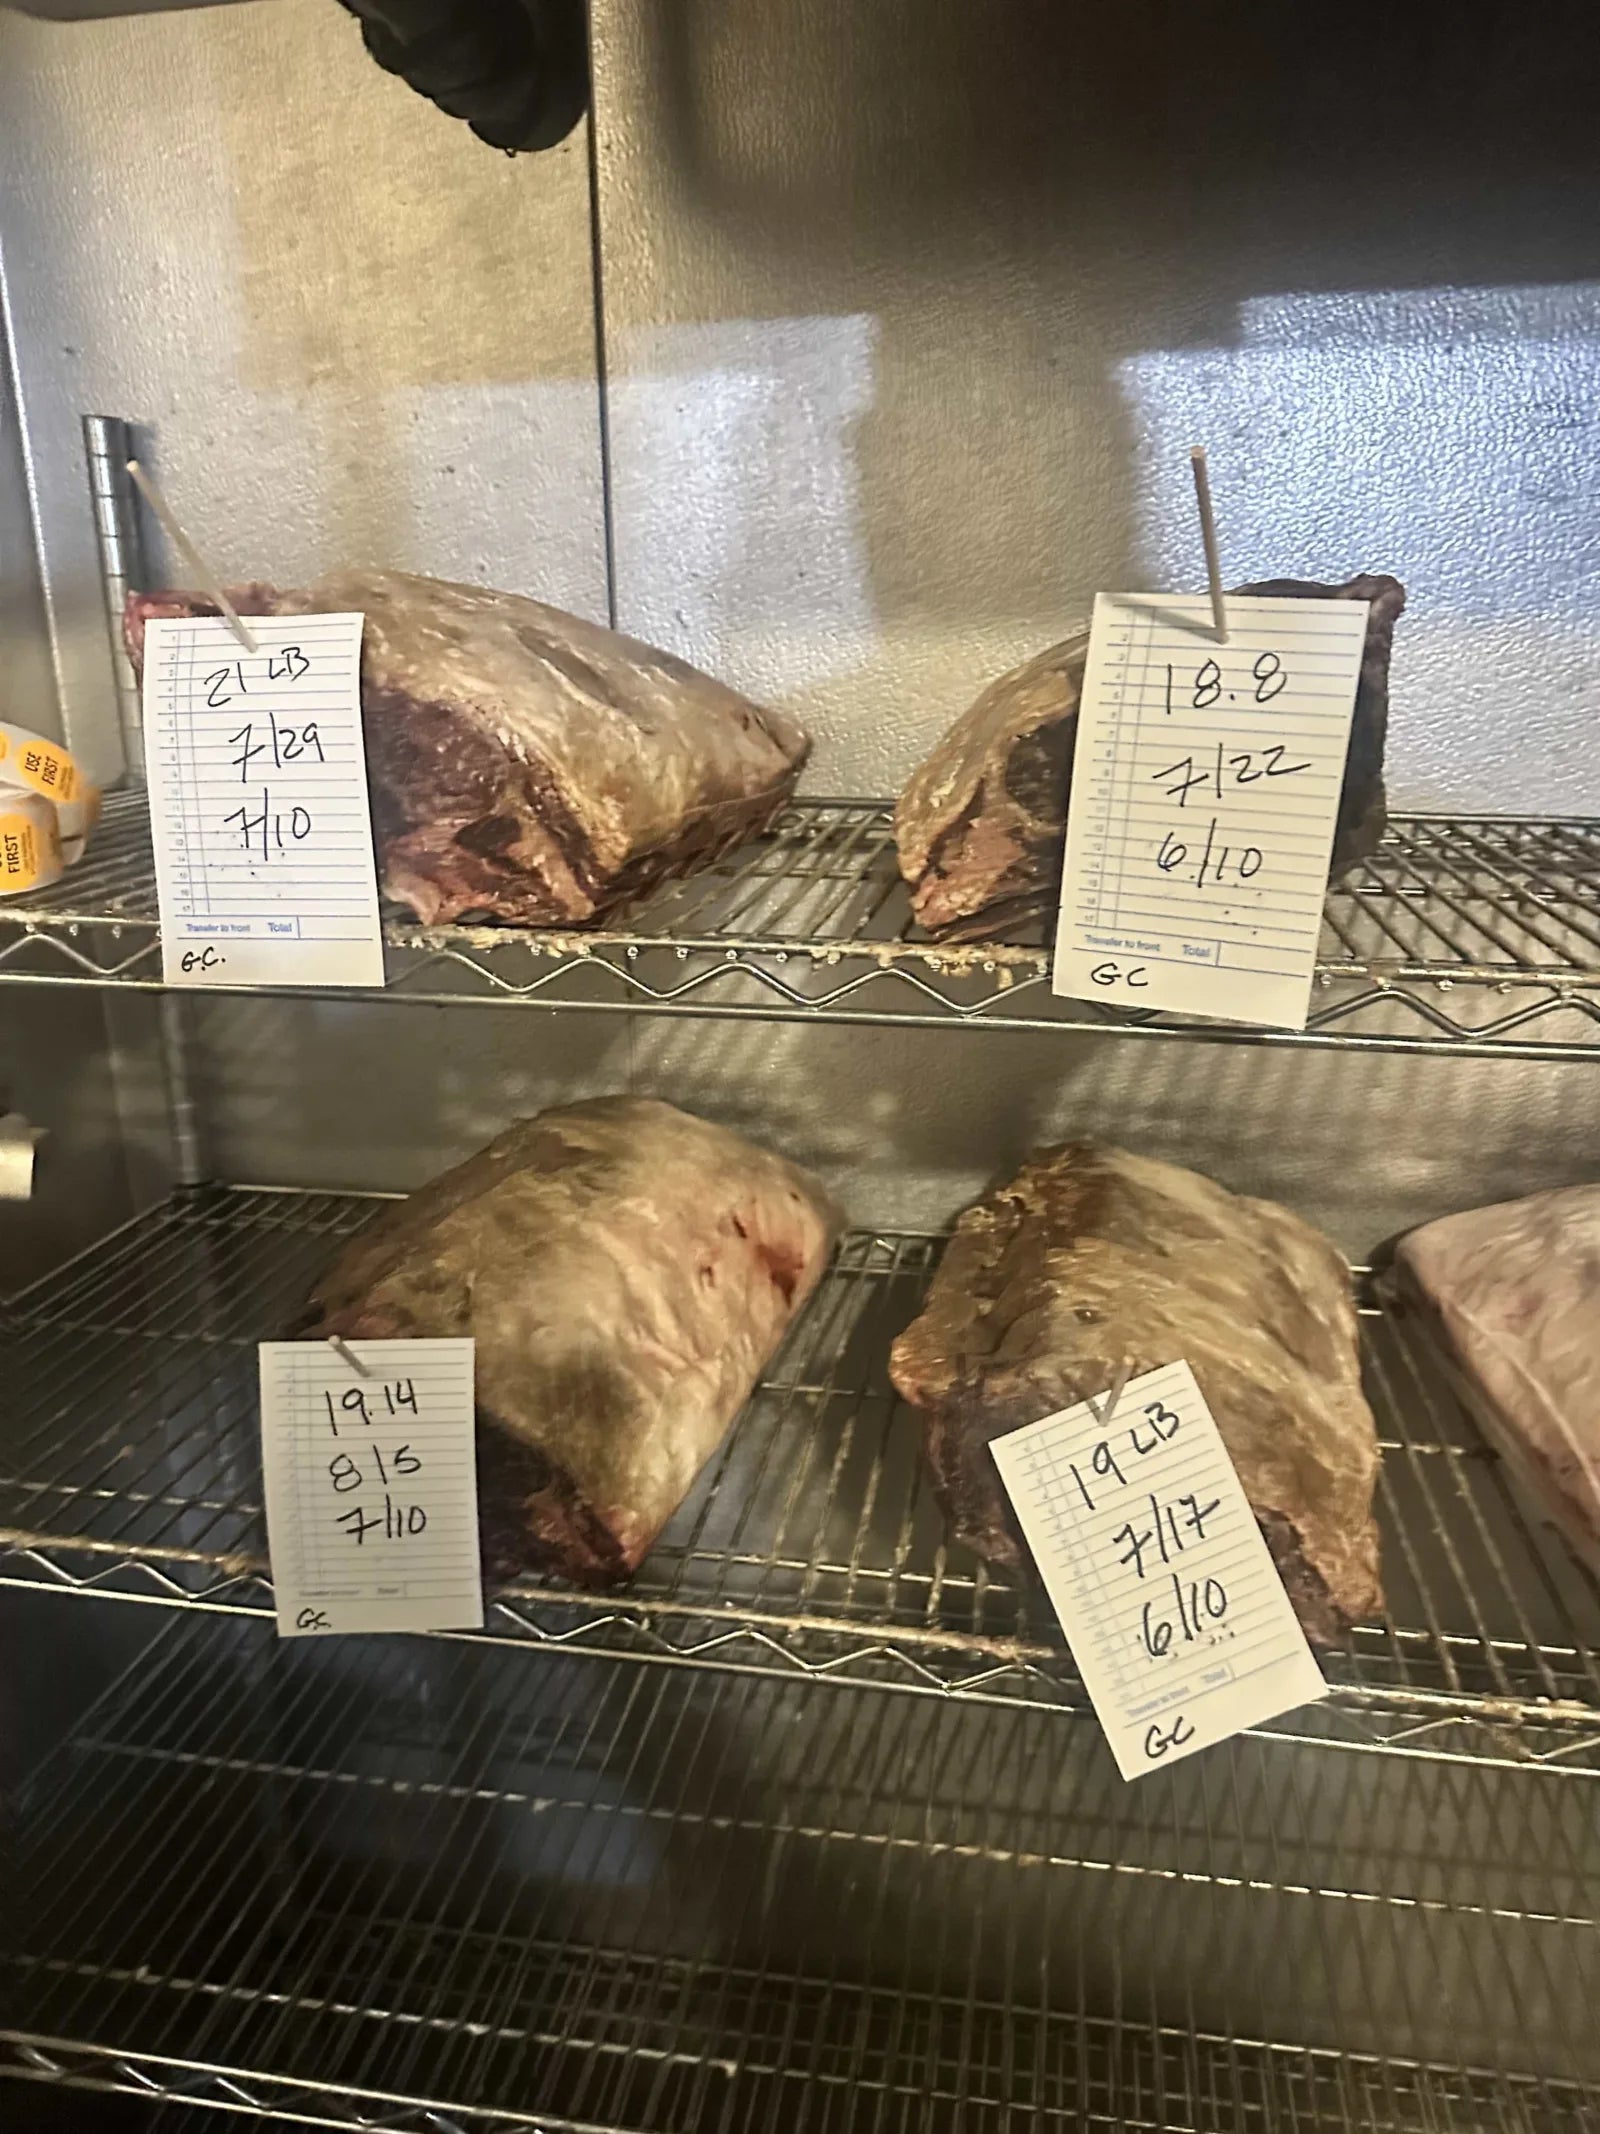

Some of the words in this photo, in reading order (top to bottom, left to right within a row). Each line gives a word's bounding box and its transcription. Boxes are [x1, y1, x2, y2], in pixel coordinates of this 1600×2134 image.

[204, 661, 247, 708] 21
[268, 646, 310, 681] LB
[1166, 652, 1287, 714] 18.8
[25, 752, 42, 772] USE
[41, 756, 58, 785] FIRST
[229, 712, 325, 783] 7/29
[1152, 743, 1312, 807] 7/22
[223, 787, 311, 861] 7/10
[4, 834, 20, 874] FIRST
[267, 922, 292, 933] Total
[1182, 943, 1210, 957] Total
[1090, 962, 1149, 987] GC
[325, 1378, 418, 1436] 19.14
[329, 1444, 422, 1492] 8/5
[1070, 1441, 1127, 1511] 19
[1129, 1402, 1179, 1455] LB
[336, 1493, 427, 1545] 7/10
[1113, 1494, 1221, 1579] 7/17
[1144, 1573, 1228, 1657] 6/10
[1144, 1716, 1195, 1759] GC
